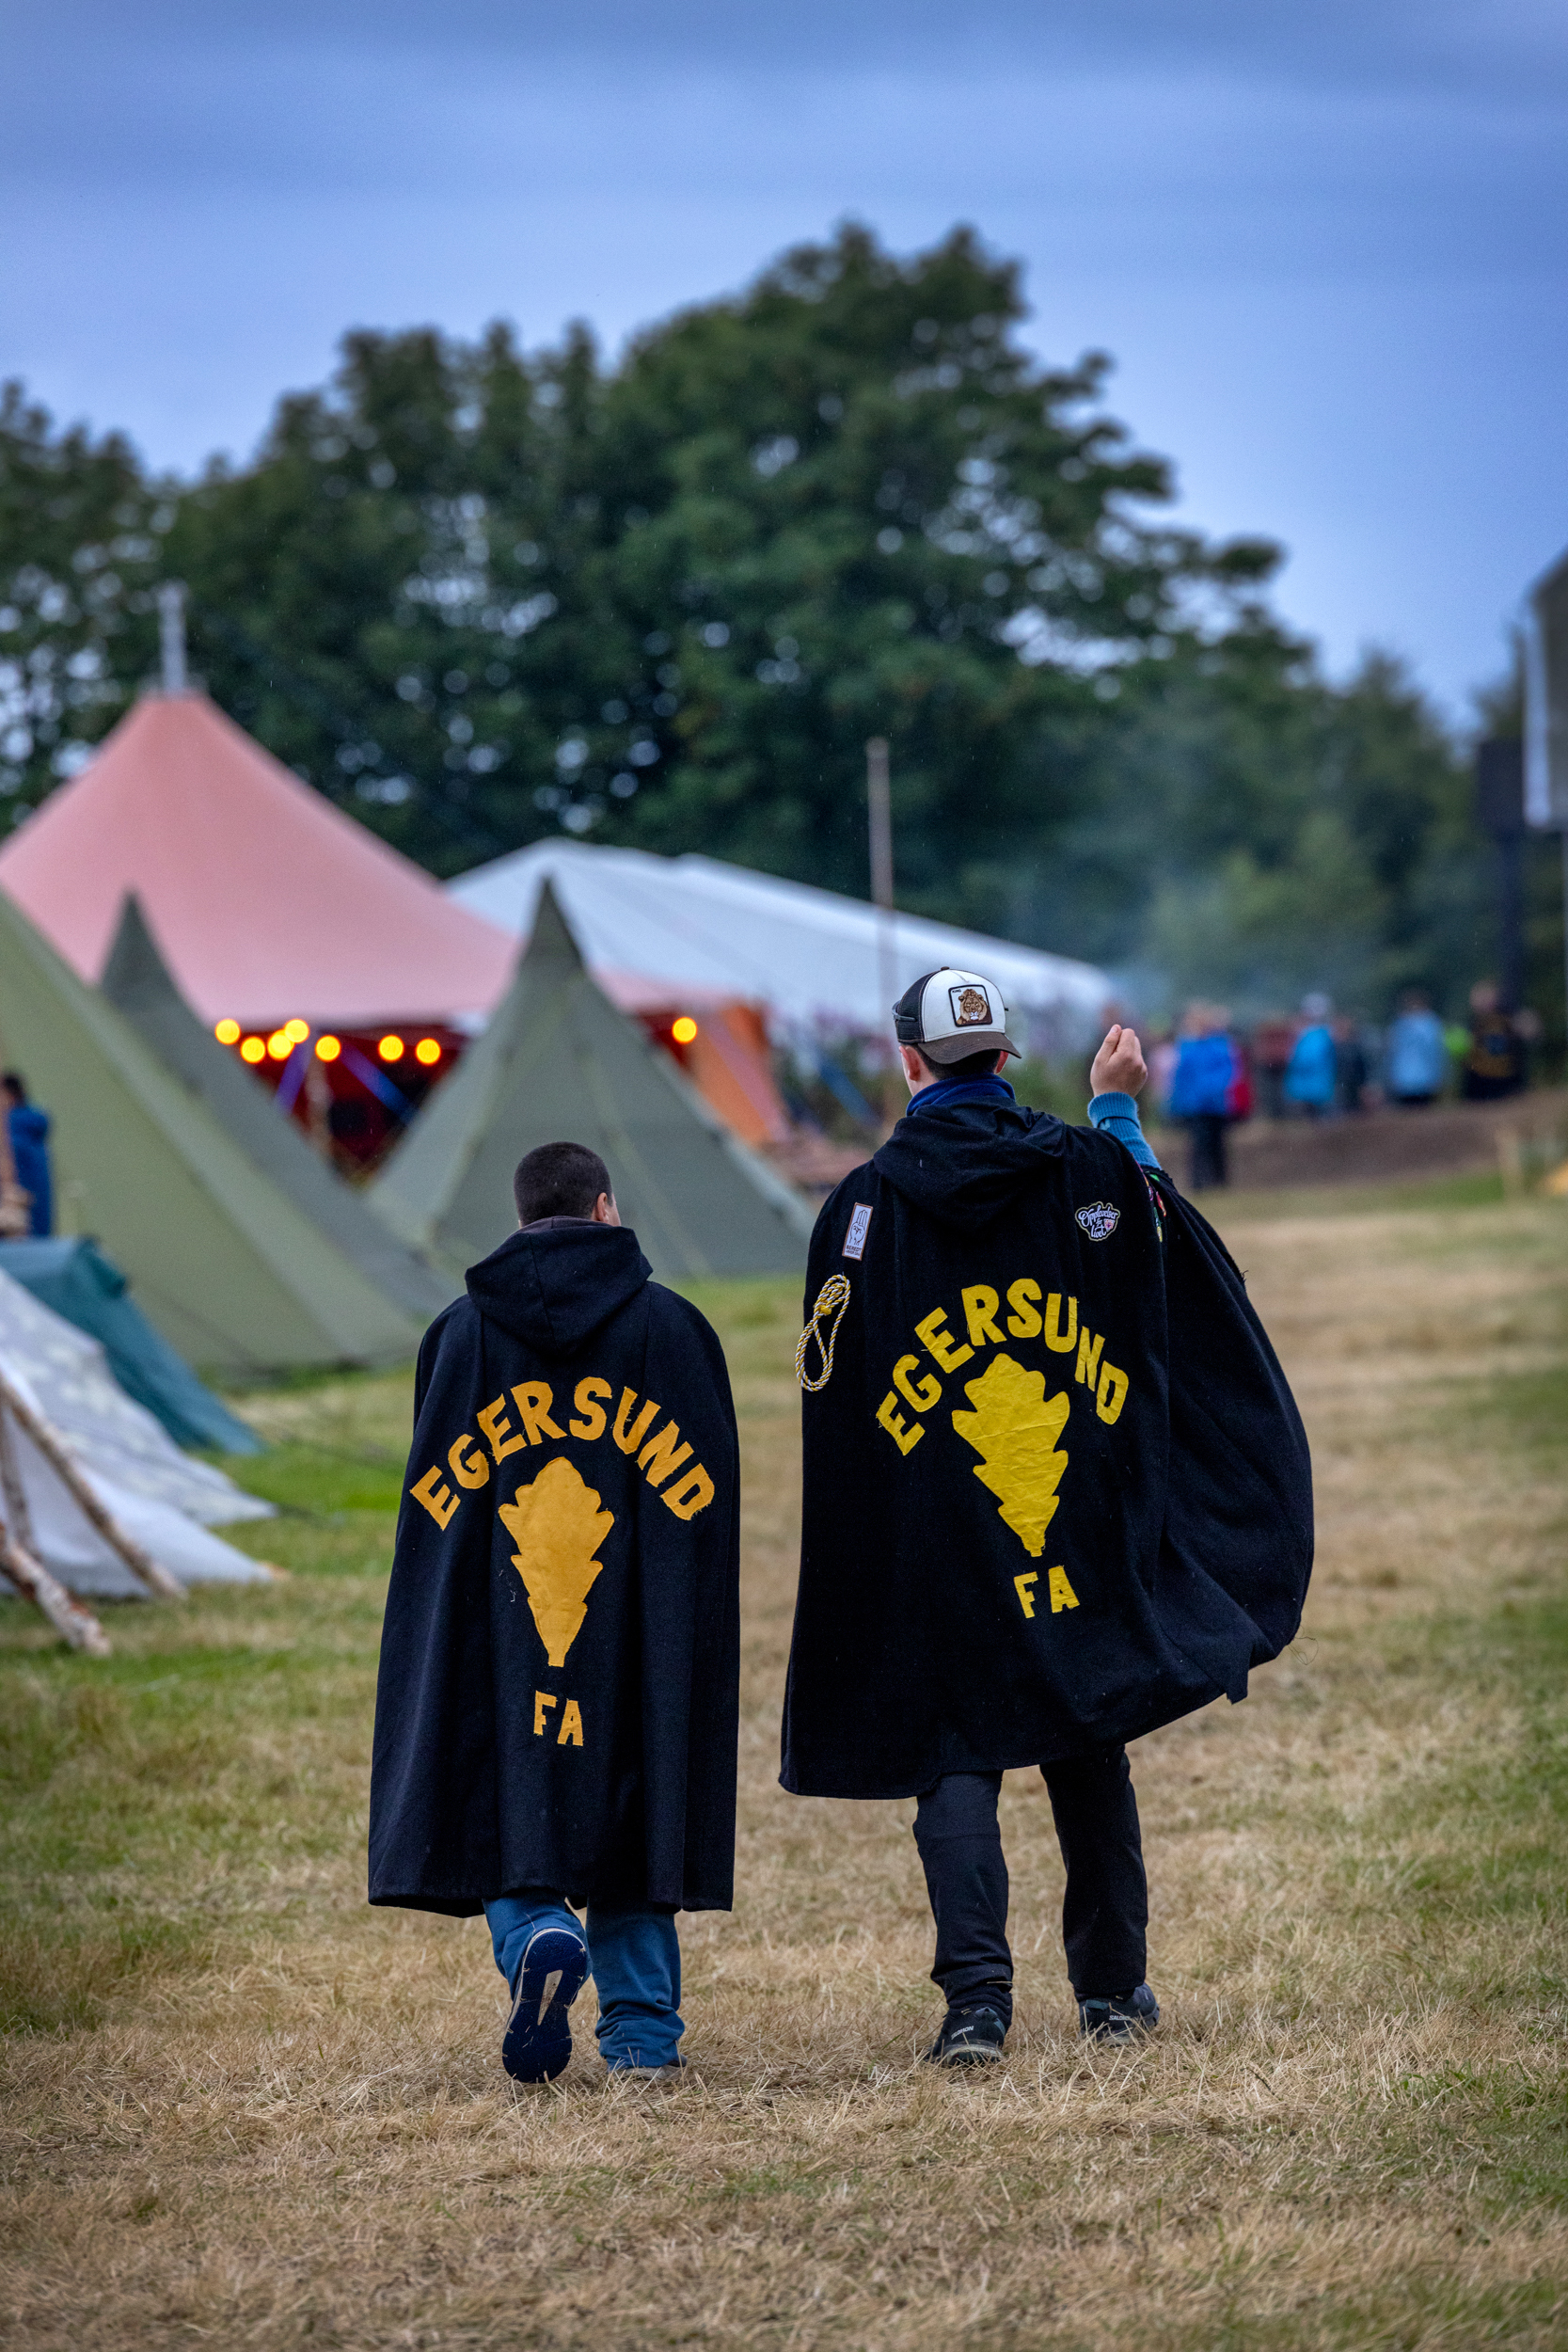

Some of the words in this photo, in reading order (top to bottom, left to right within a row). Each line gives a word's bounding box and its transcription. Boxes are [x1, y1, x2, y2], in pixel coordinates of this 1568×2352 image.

[876, 1279, 1129, 1455] EGERSUND
[410, 1376, 714, 1530] EGERSUND
[1014, 1565, 1080, 1618] FA
[533, 1690, 583, 1746] FA
